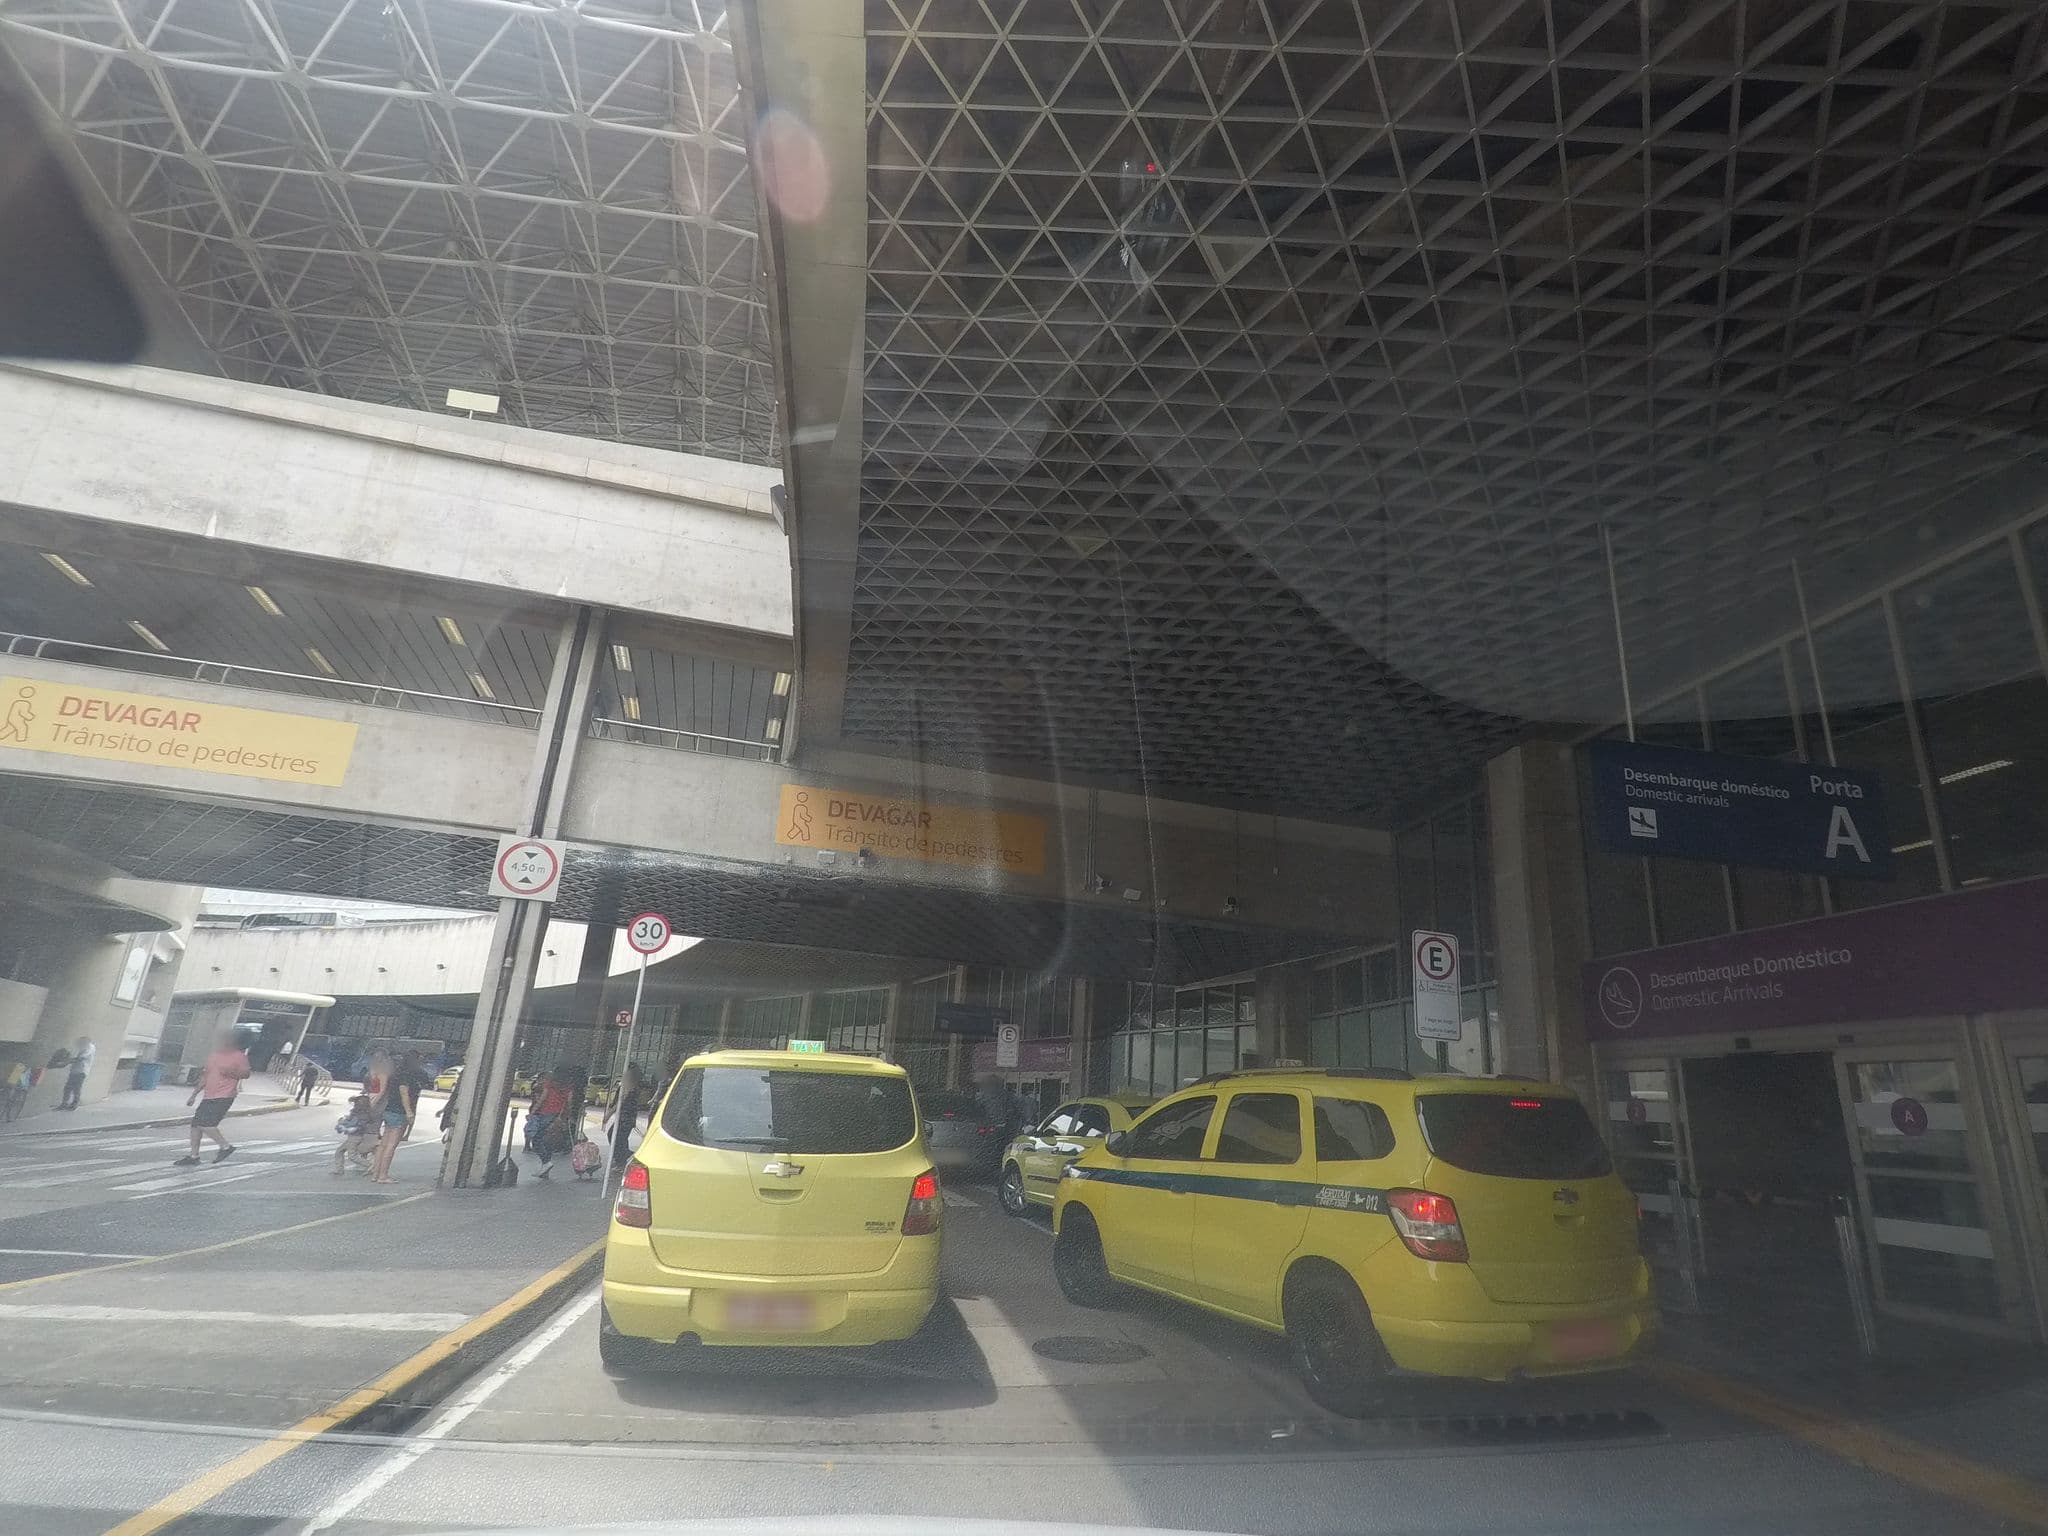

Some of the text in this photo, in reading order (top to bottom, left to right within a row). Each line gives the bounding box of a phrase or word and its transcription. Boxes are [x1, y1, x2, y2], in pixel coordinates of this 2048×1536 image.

[58, 696, 201, 733] DEVAGAR
[50, 723, 319, 775] Trânsito de pedestres
[1624, 767, 1790, 799] Desembarque doméstico
[1625, 784, 1730, 808] Domestic arrivals
[1809, 774, 1864, 799] Porta
[827, 799, 931, 829] DEVAGAR
[825, 823, 1024, 864] Trânsito de pedestres
[1825, 805, 1872, 864] A
[511, 862, 535, 873] 4,50
[635, 921, 663, 940] 30
[1429, 946, 1443, 972] E
[1649, 948, 1852, 990] Desembarque Doméstico
[1652, 981, 1784, 1010] Domestic Arrivals
[1005, 1029, 1013, 1041] E
[1905, 1110, 1915, 1122] A
[1365, 1194, 1379, 1211] 012
